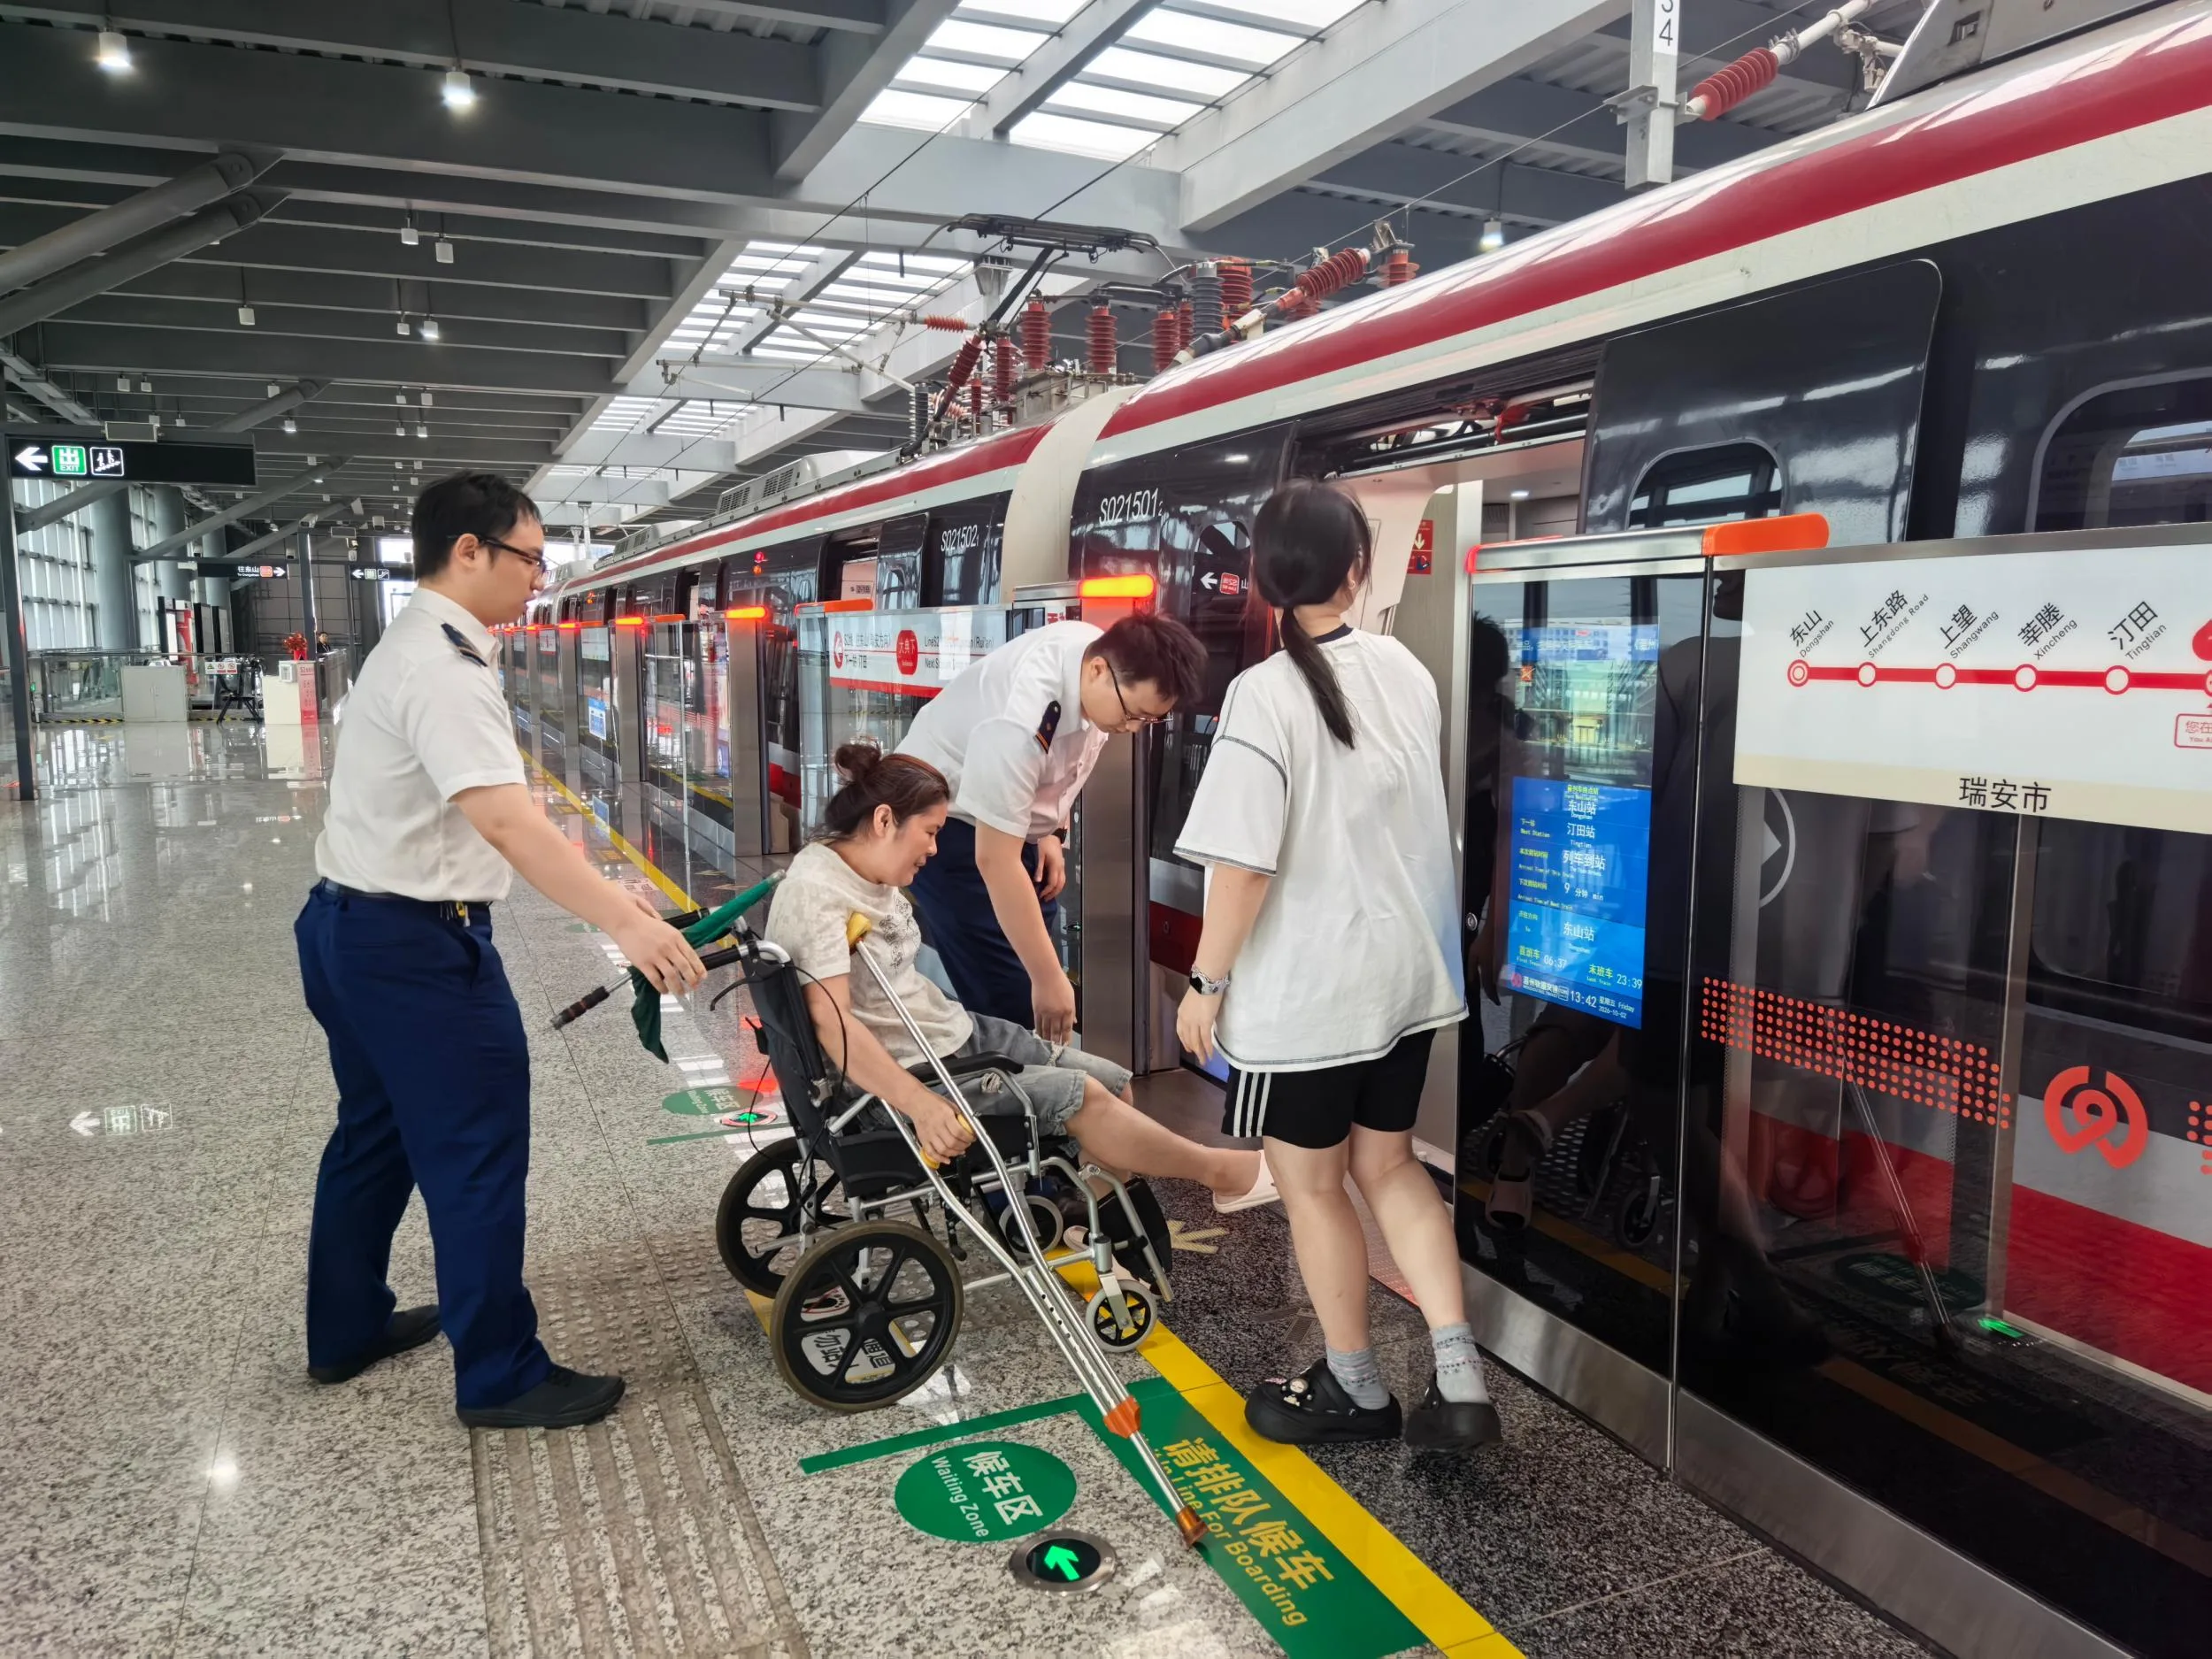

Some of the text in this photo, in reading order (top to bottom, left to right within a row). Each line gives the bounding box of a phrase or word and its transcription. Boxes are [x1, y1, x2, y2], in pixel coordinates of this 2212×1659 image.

[59, 449, 81, 465] 出
[1099, 488, 1158, 526] S021501
[941, 524, 978, 552] S021502
[1789, 610, 1823, 647] 东山
[1859, 589, 1909, 648] 上东路
[1868, 594, 1929, 658] Shangdong Road
[1939, 603, 1978, 649] 上望
[1950, 611, 2000, 659] Shangwang
[2017, 602, 2065, 647] 莘塍
[2108, 601, 2159, 650] 汀田
[1800, 619, 1834, 657] Dongshan
[2033, 619, 2078, 660] Xincheng
[2124, 623, 2167, 661] Tingtian
[1567, 799, 1596, 816] 东山站
[1959, 776, 2052, 813] 瑞安市
[1566, 822, 1595, 839] 汀田站
[1563, 849, 1607, 871] 列车到站
[1563, 882, 1571, 894] 9
[1563, 921, 1595, 942] 东山站
[1588, 963, 1643, 990] 末班车 23:39
[1570, 990, 1598, 1008] 13:42
[931, 1455, 989, 1538] Waiting Zone
[963, 1450, 1044, 1525] 候车区
[1163, 1437, 1335, 1590] 请排队候车
[1199, 1510, 1232, 1540] For
[1224, 1541, 1308, 1627] Boarding
